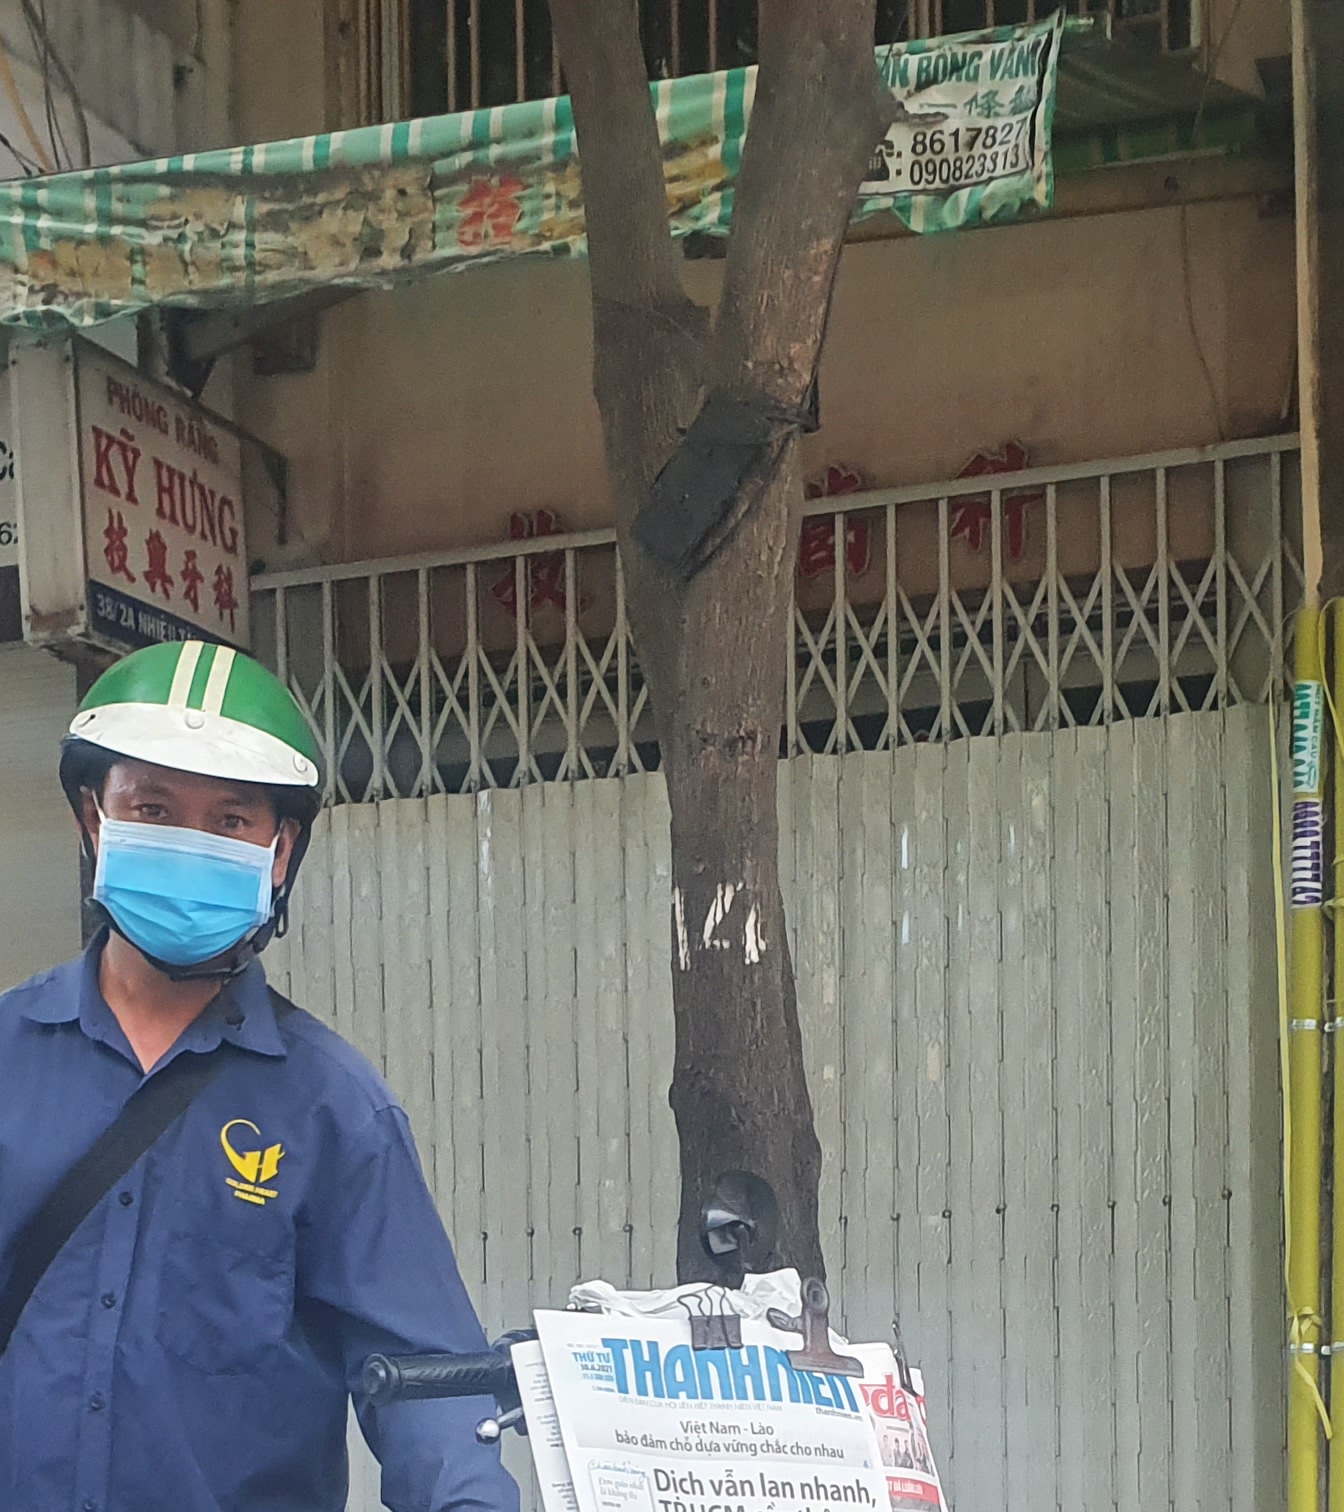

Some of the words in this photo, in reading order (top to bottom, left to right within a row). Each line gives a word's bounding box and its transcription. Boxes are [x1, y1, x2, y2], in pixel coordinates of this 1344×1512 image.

[910, 115, 1028, 157] 8617827
[92, 425, 142, 506] KỸ
[152, 455, 239, 557] HƯNG
[615, 1429, 639, 1447] bảo
[640, 1432, 667, 1451] đảm
[669, 1434, 693, 1452] chỗ
[695, 1436, 721, 1457] dựa
[723, 1437, 757, 1457] vững
[760, 1437, 789, 1455] chắc
[790, 1441, 812, 1456] cho
[814, 1442, 844, 1460] nhau
[679, 1420, 708, 1438] Việt
[709, 1421, 742, 1435] Nam
[751, 1421, 775, 1436] Lào
[653, 1468, 704, 1501] Dịch
[708, 1468, 755, 1498] vẫn
[759, 1473, 798, 1500] lan
[800, 1475, 877, 1508] nhanh,
